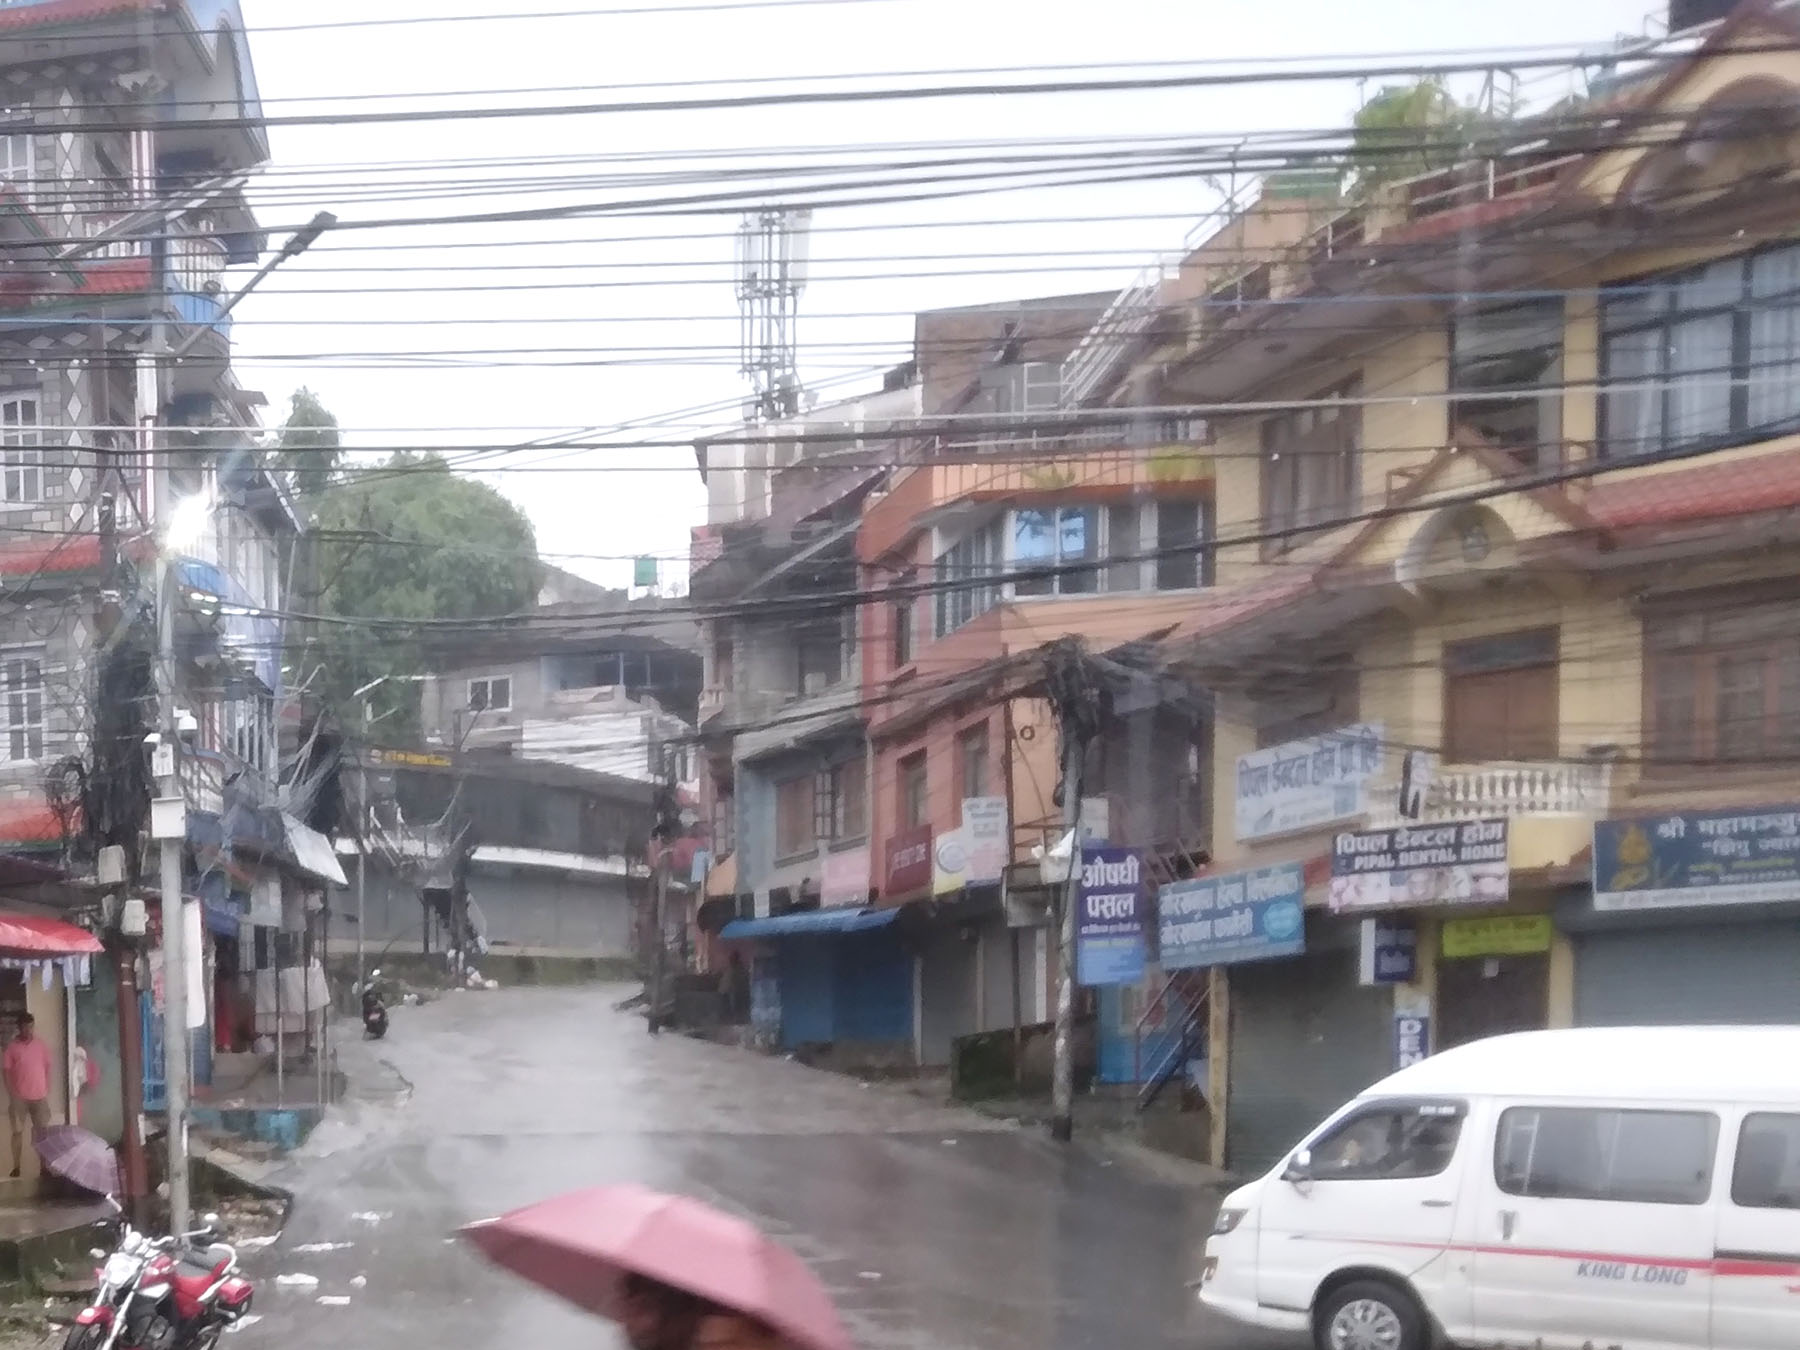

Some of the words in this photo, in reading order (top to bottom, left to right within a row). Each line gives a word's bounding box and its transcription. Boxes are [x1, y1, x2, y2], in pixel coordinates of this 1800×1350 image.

[1354, 853, 1396, 870] PIPAL
[1399, 848, 1457, 867] DENTAL
[1461, 842, 1505, 861] HOME
[1086, 893, 1136, 919] पसल
[1577, 1261, 1627, 1281] KING
[1631, 1266, 1689, 1287] LONG
